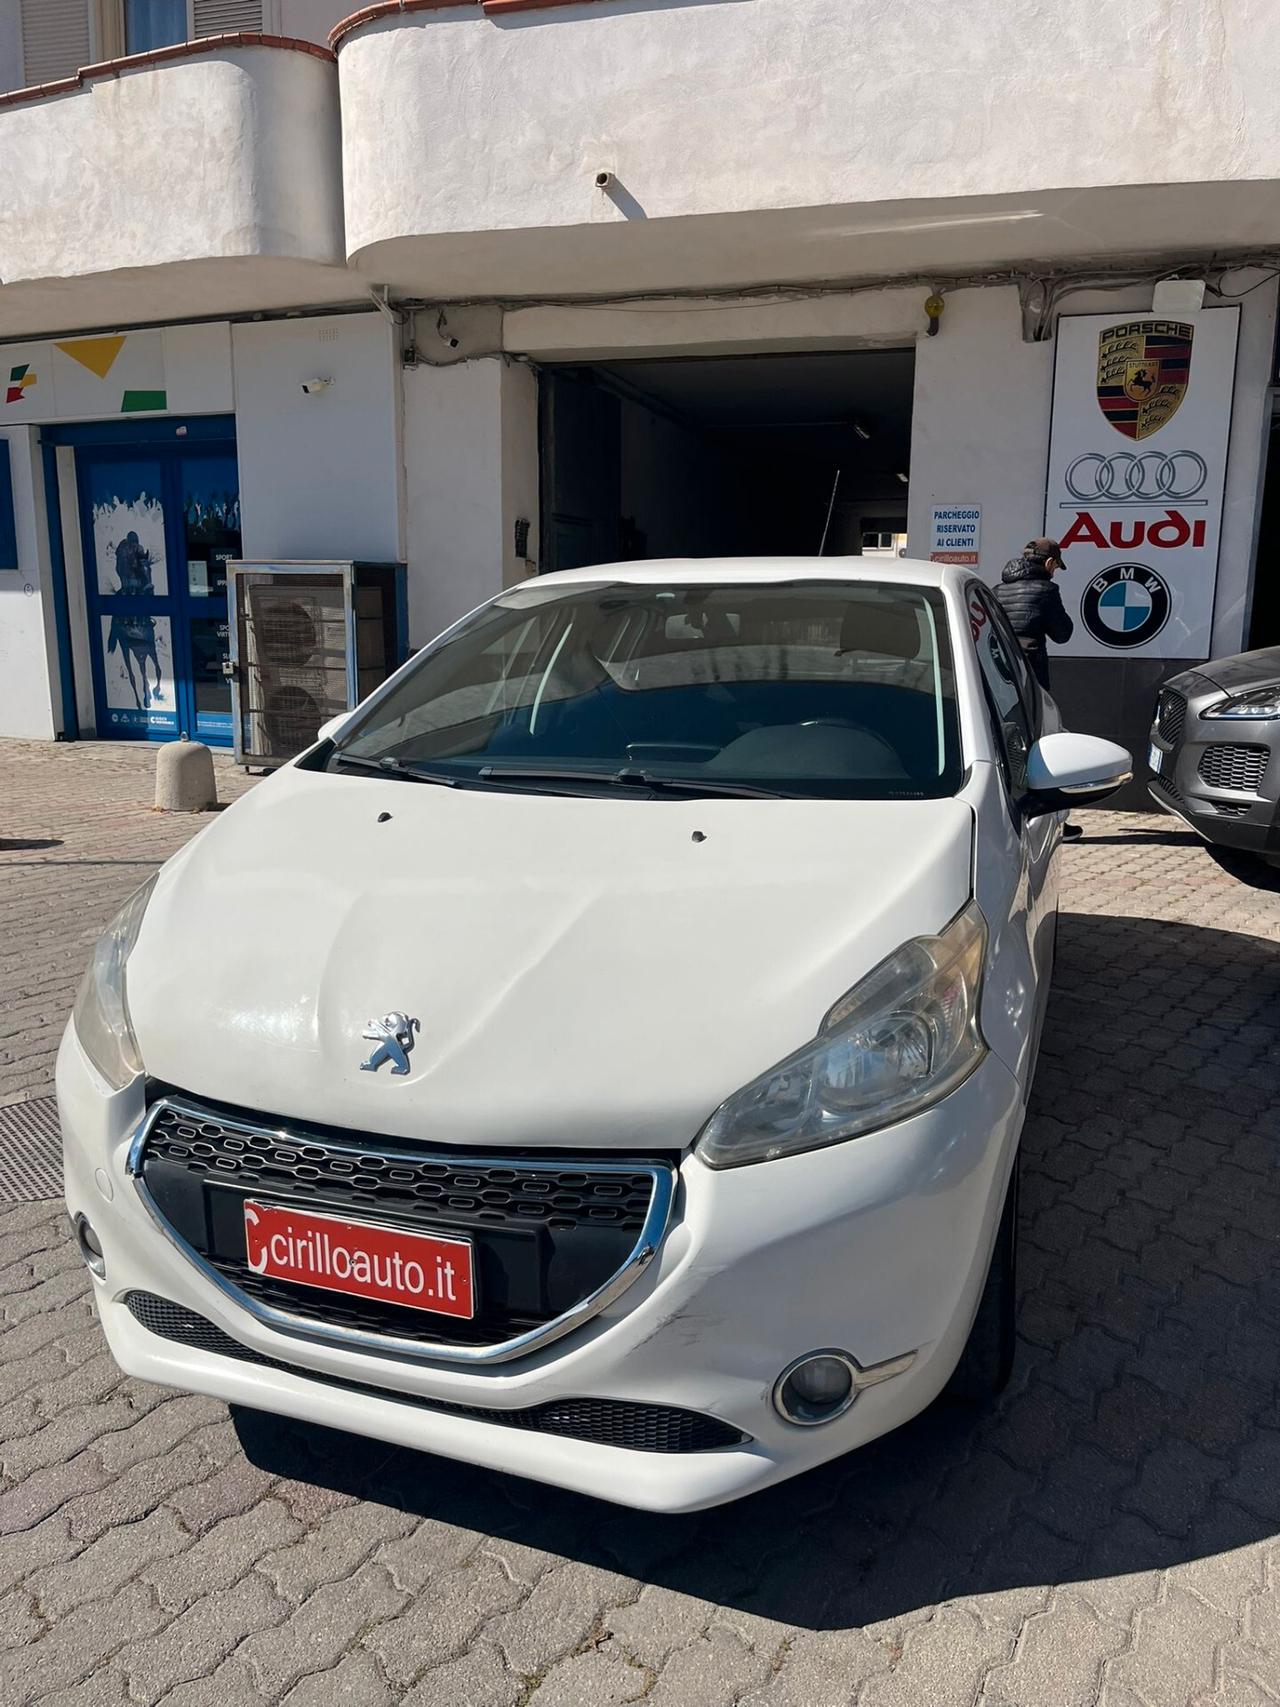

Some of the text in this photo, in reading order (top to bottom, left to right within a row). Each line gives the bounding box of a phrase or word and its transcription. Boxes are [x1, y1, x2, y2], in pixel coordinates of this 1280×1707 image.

[1101, 323, 1191, 344] PORSCHE
[934, 511, 980, 520] PARCHEGGIO
[936, 524, 976, 533] RISERVATO
[1059, 510, 1206, 549] Audi
[937, 538, 974, 547] AI CLIENTI
[1091, 567, 1162, 593] BMW
[271, 1226, 457, 1301] cirilloauto.it
